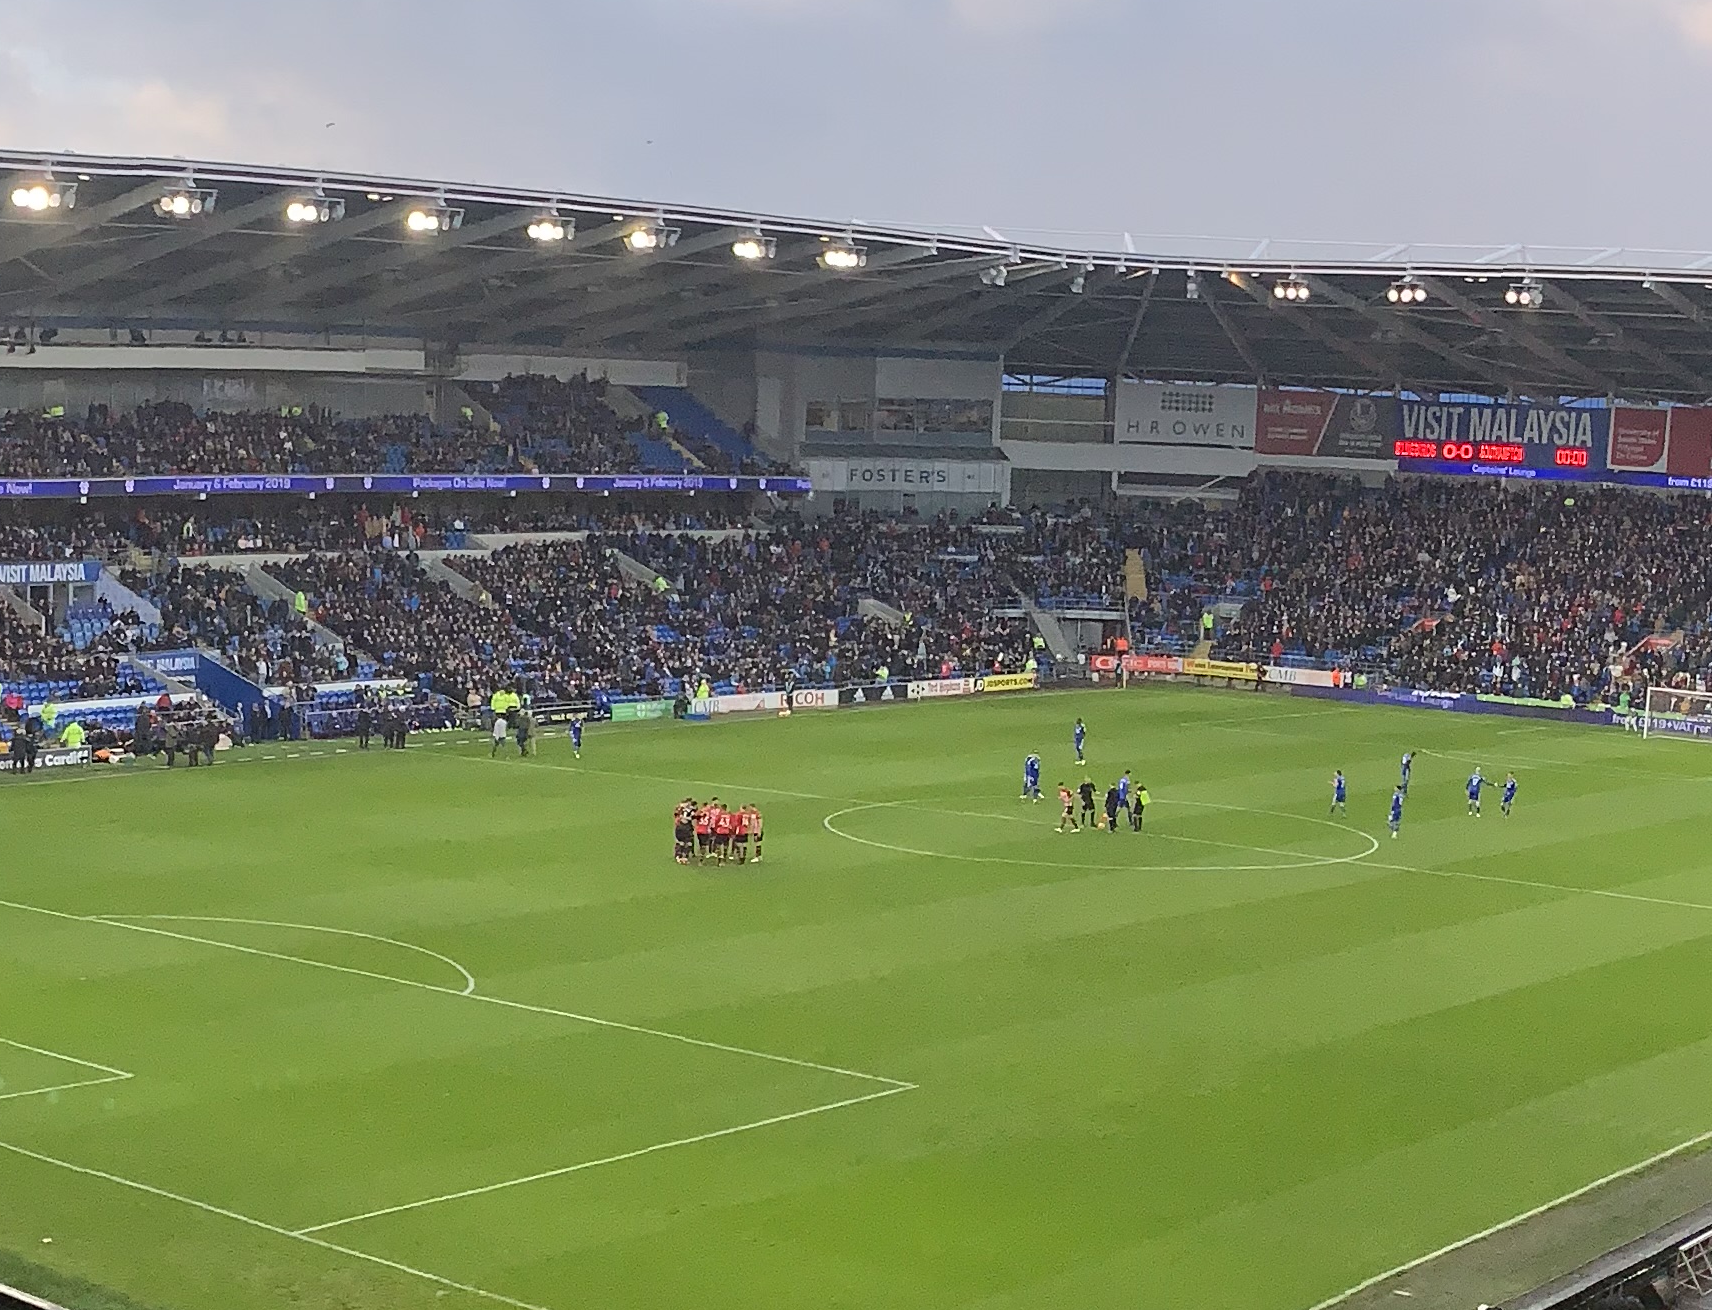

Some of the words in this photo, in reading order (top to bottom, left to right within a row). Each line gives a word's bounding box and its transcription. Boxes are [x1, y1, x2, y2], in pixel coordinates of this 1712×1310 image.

[1172, 421, 1245, 438] OWEN
[1403, 404, 1465, 441] VISIT
[1469, 408, 1592, 447] MALAYSIA
[849, 467, 947, 484] FOSTER'S
[1668, 477, 1689, 487] from
[6, 482, 33, 494] Now!
[173, 479, 212, 491] January
[223, 478, 264, 490] February
[265, 478, 290, 489] 2019
[29, 563, 85, 582] MALAYSIA
[781, 691, 825, 706] RCOH
